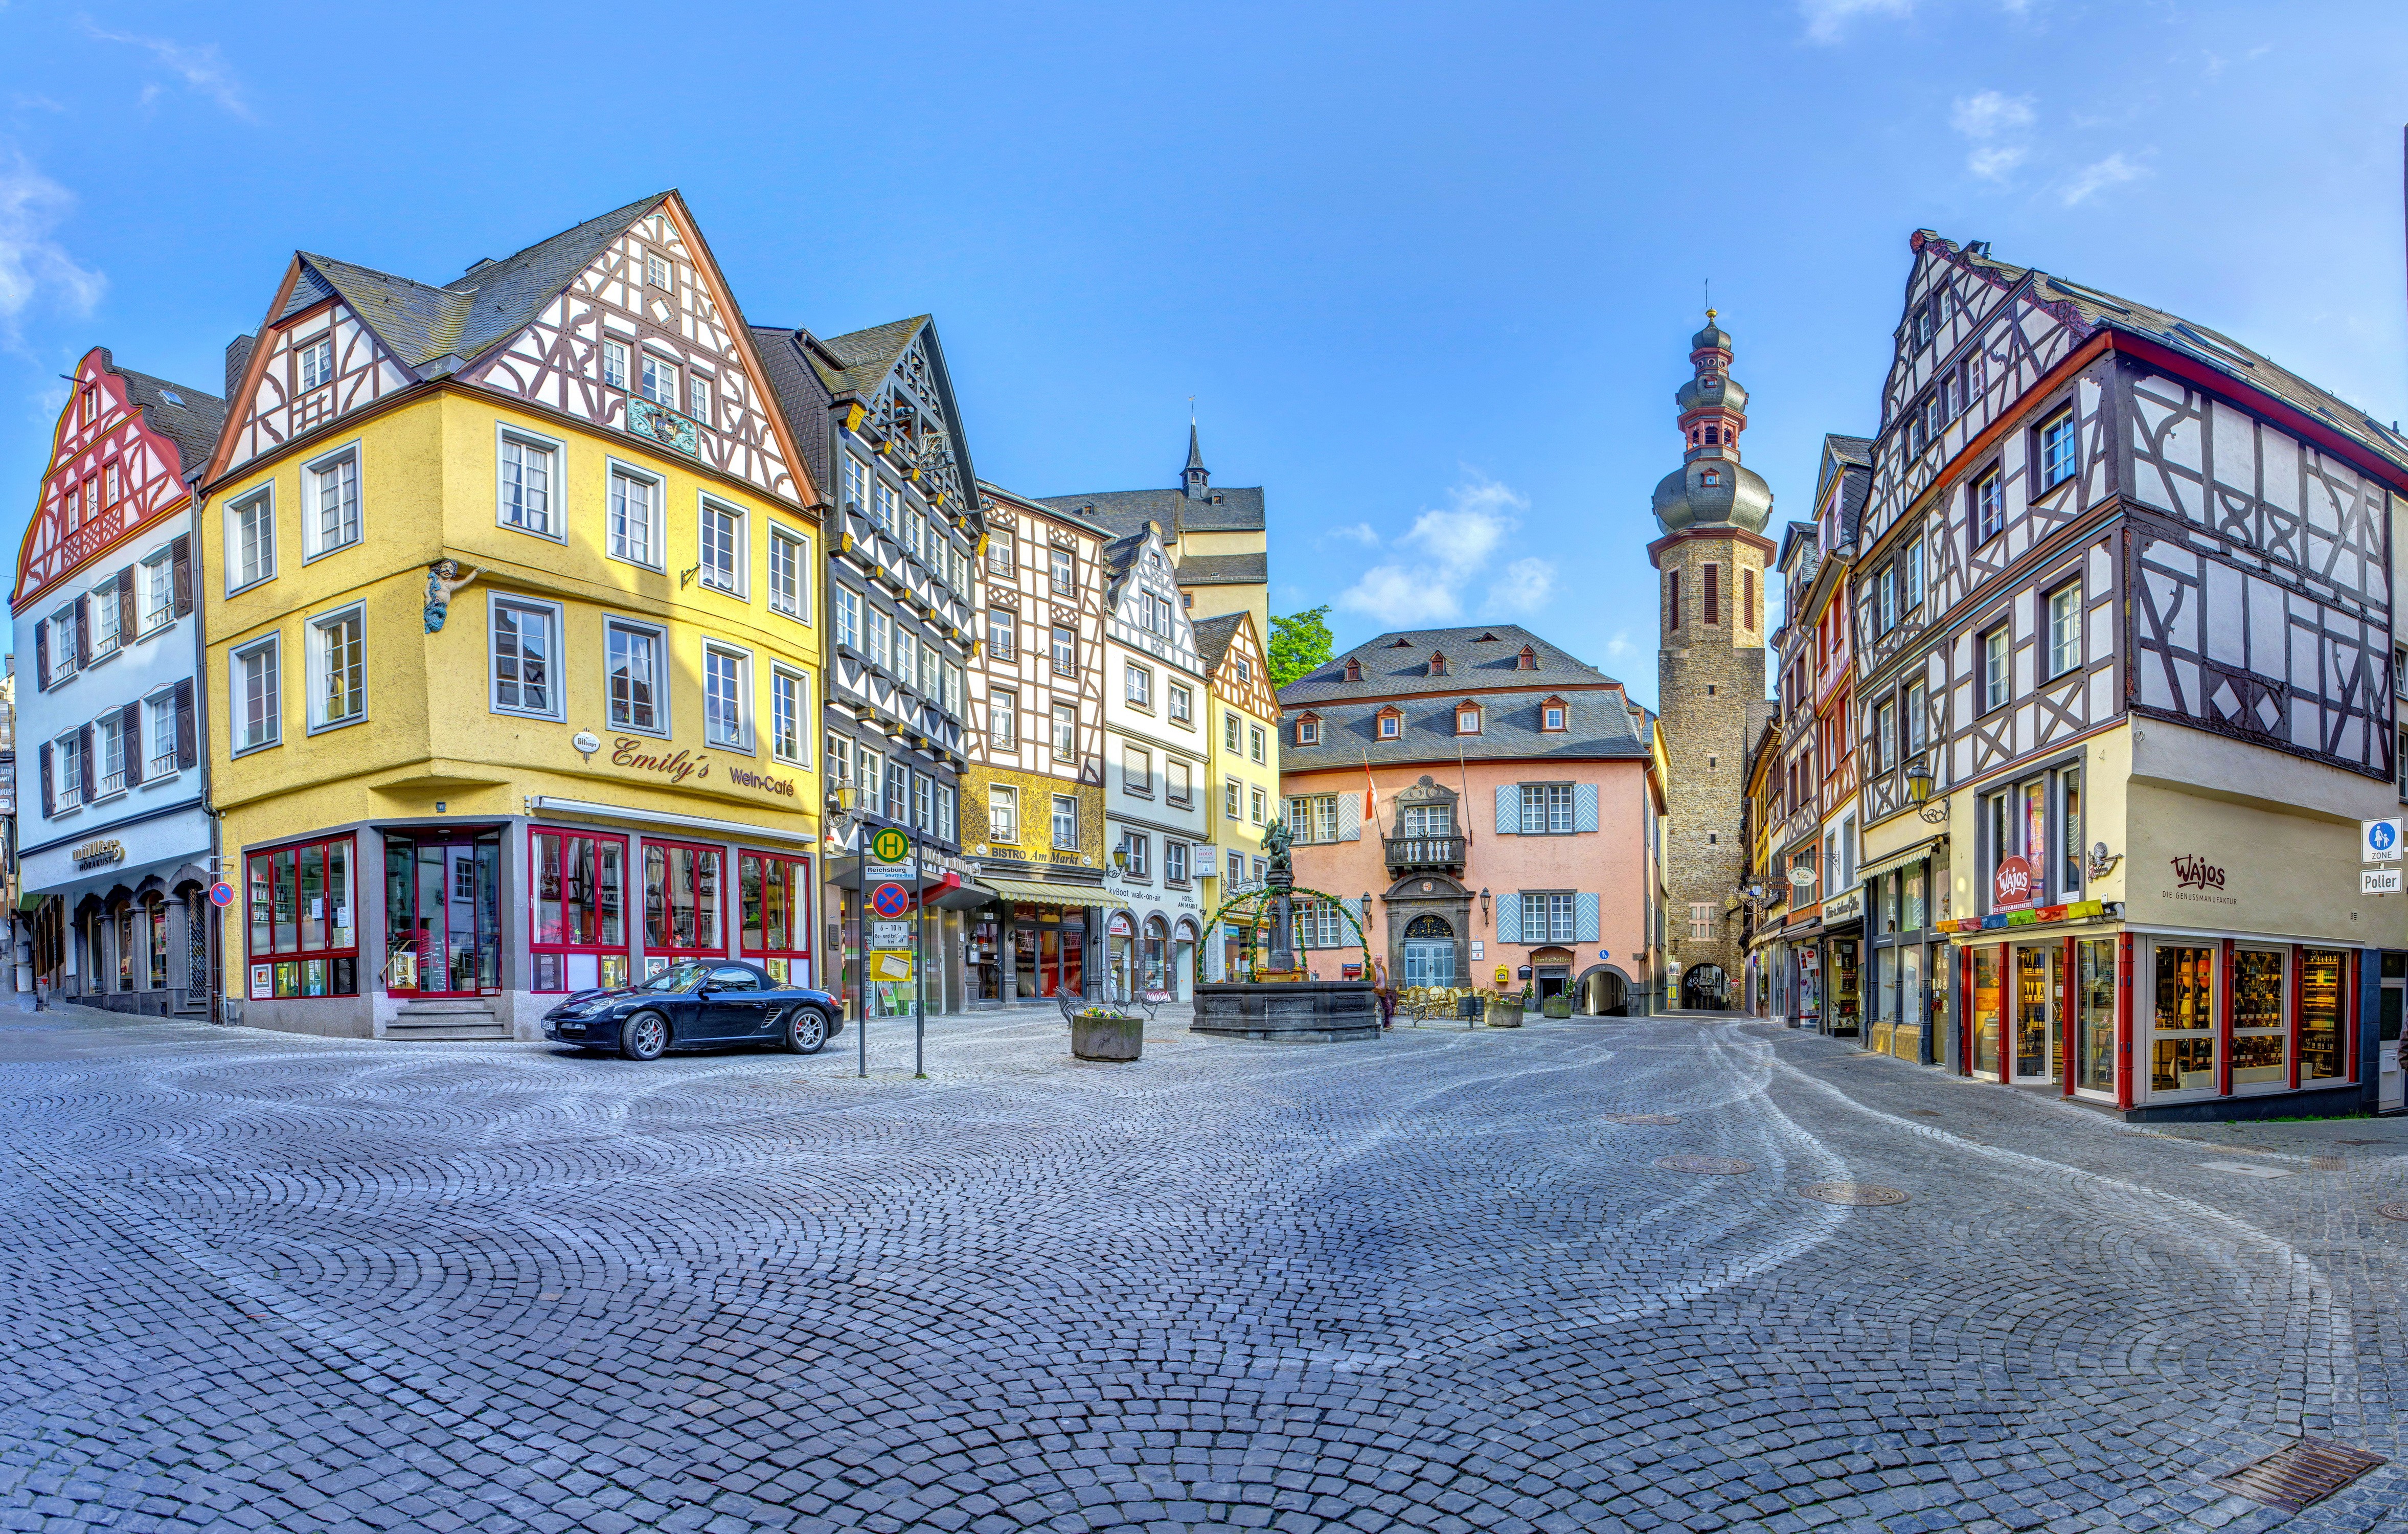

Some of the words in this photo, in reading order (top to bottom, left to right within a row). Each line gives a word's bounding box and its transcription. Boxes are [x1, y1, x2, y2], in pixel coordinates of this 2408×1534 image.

[577, 738, 597, 748] Bitburger
[730, 766, 794, 797] Wein-Café
[73, 839, 120, 861] müller
[883, 837, 898, 855] H
[79, 855, 119, 871] HÖRAKUSTI
[992, 847, 1026, 860] BISTRO
[1030, 850, 1047, 861] Am
[1050, 851, 1079, 865] Markt
[2372, 851, 2392, 860] ZONE
[2365, 874, 2397, 889] Poller
[1109, 887, 1129, 897] kyBoot
[1131, 891, 1161, 901] walk-on-air
[2176, 892, 2237, 905] GENUSSMANUFAKTUR
[2000, 902, 2032, 912] GENUSSMANUFAKTUR
